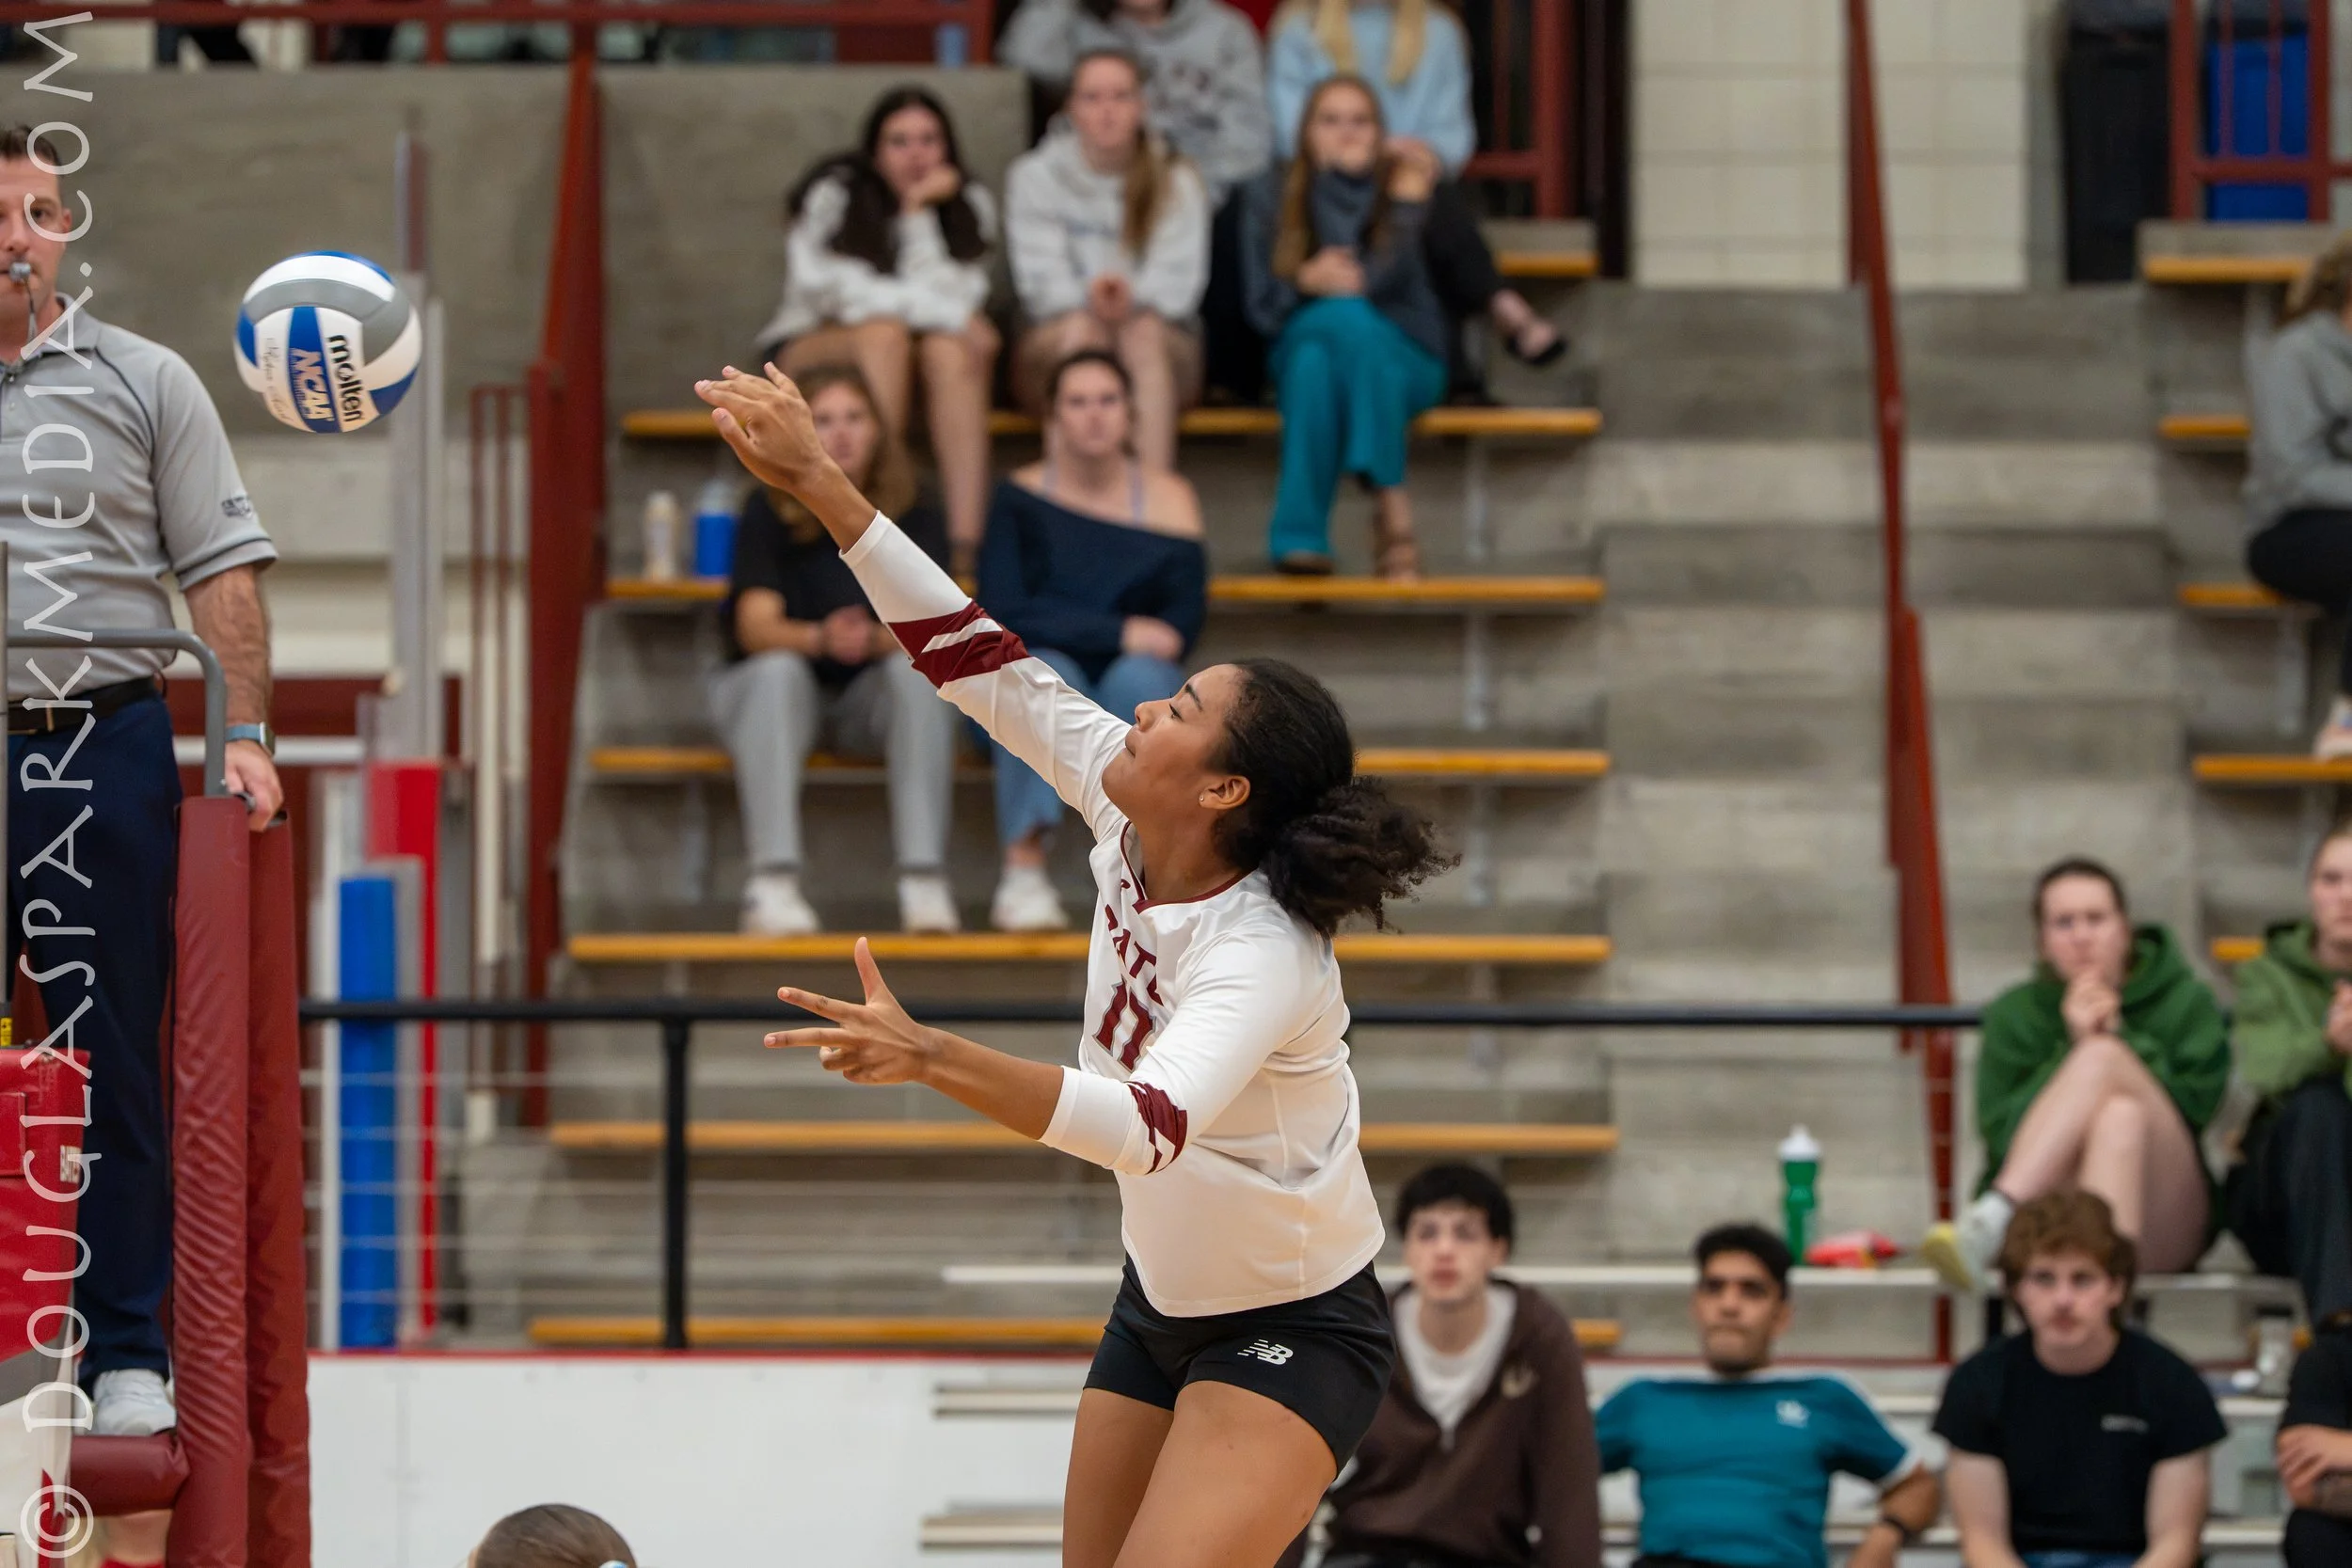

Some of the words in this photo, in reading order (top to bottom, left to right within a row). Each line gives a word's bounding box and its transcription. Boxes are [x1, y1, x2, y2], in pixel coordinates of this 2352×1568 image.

[288, 346, 335, 422] NCAA
[327, 334, 365, 422] molten
[1092, 973, 1157, 1074] 11
